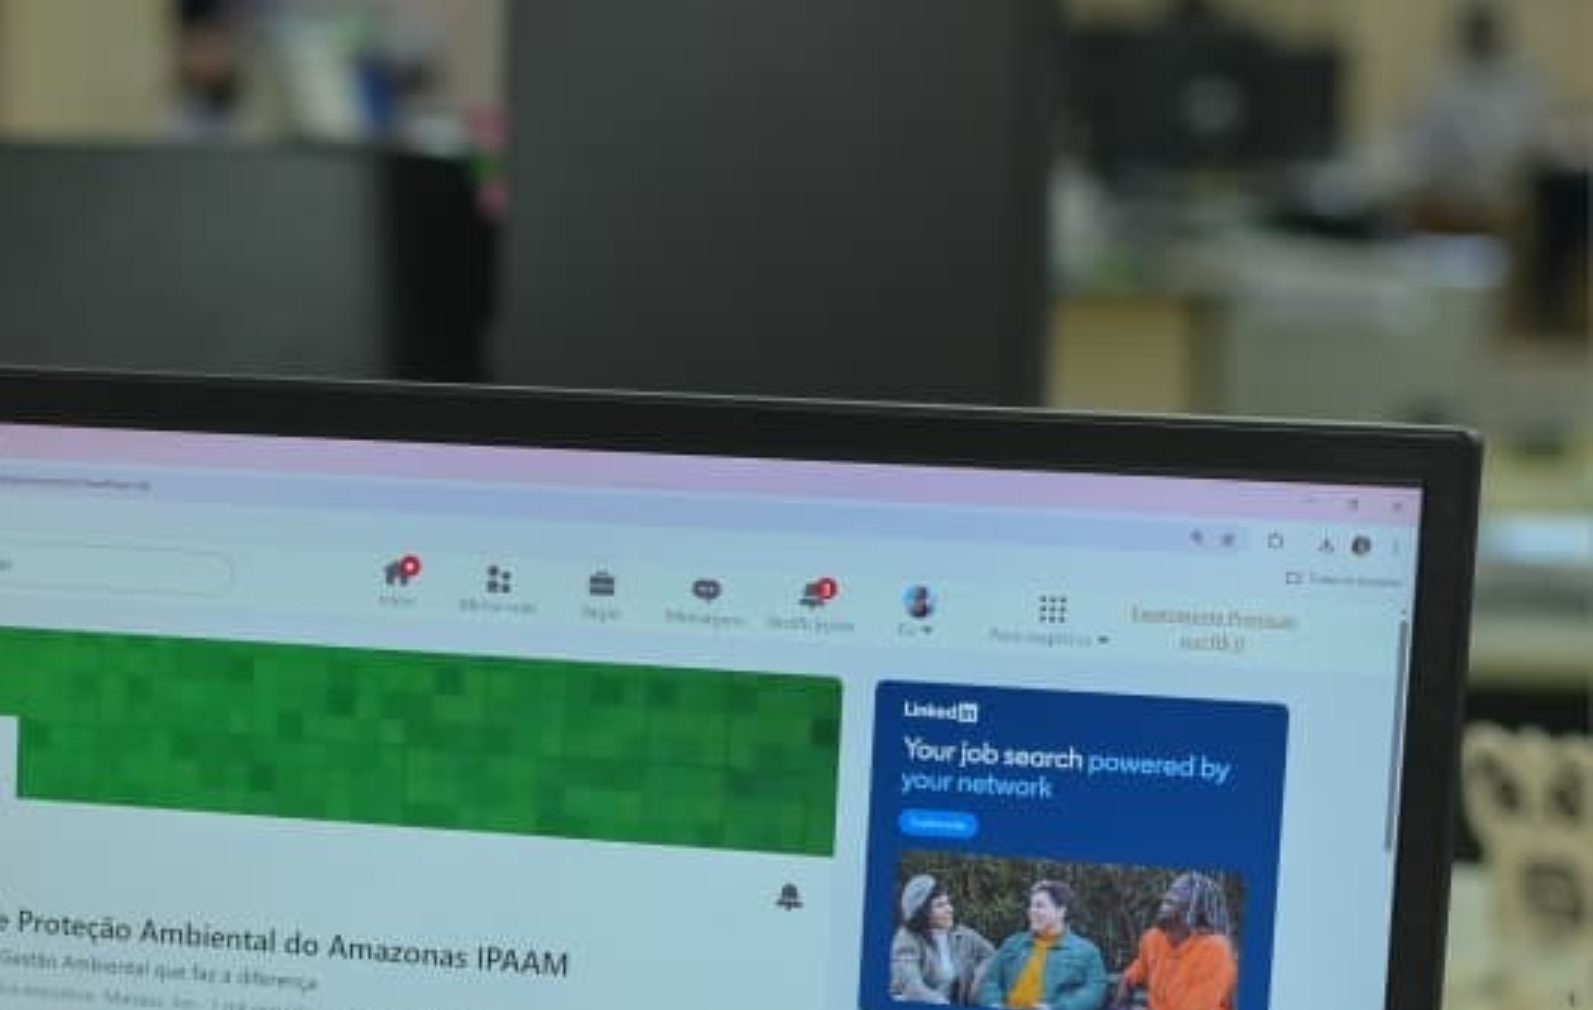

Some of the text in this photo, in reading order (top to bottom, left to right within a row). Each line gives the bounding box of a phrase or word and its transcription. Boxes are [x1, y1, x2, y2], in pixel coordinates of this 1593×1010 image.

[903, 735, 1233, 785] Your job search powered by
[900, 771, 1054, 799] your network
[17, 909, 132, 944] Proteção
[139, 916, 276, 954] Ambiental
[283, 929, 319, 957] do
[327, 934, 469, 970] Amazonas
[476, 945, 570, 978] IPAAM
[61, 955, 150, 978] Ambiental
[154, 964, 187, 984] que
